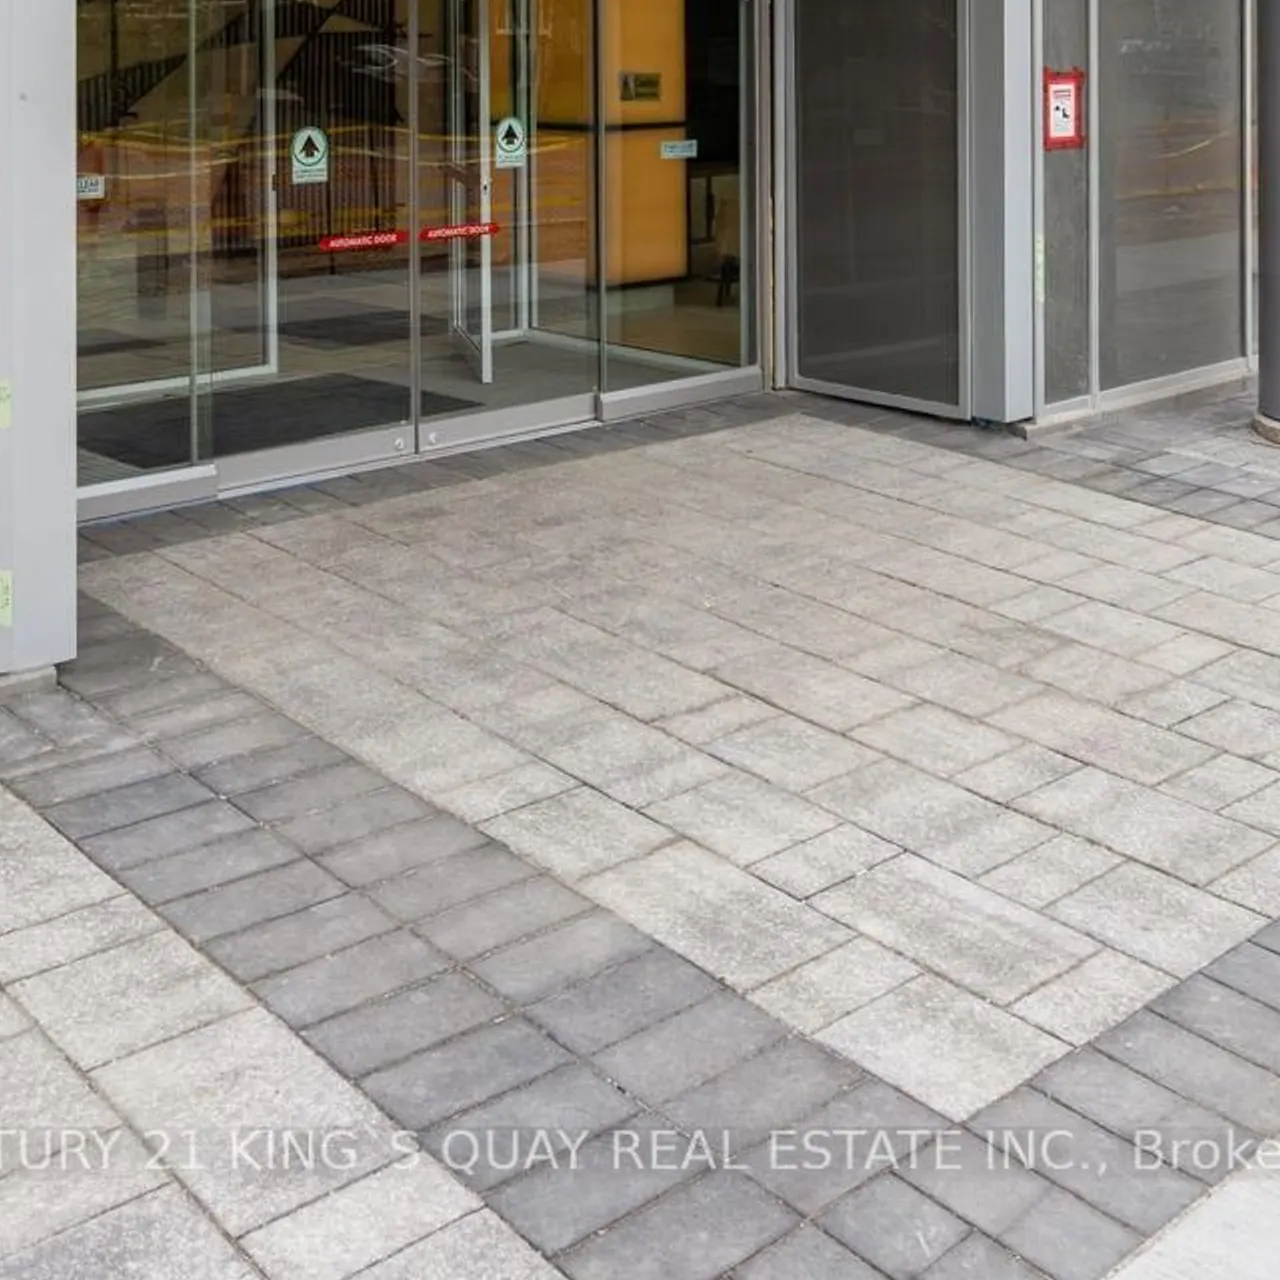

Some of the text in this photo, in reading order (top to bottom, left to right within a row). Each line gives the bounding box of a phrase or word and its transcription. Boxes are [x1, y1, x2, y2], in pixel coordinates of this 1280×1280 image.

[427, 226, 468, 238] AUTOMATIC
[328, 233, 399, 248] AUTOMATIC DOOR
